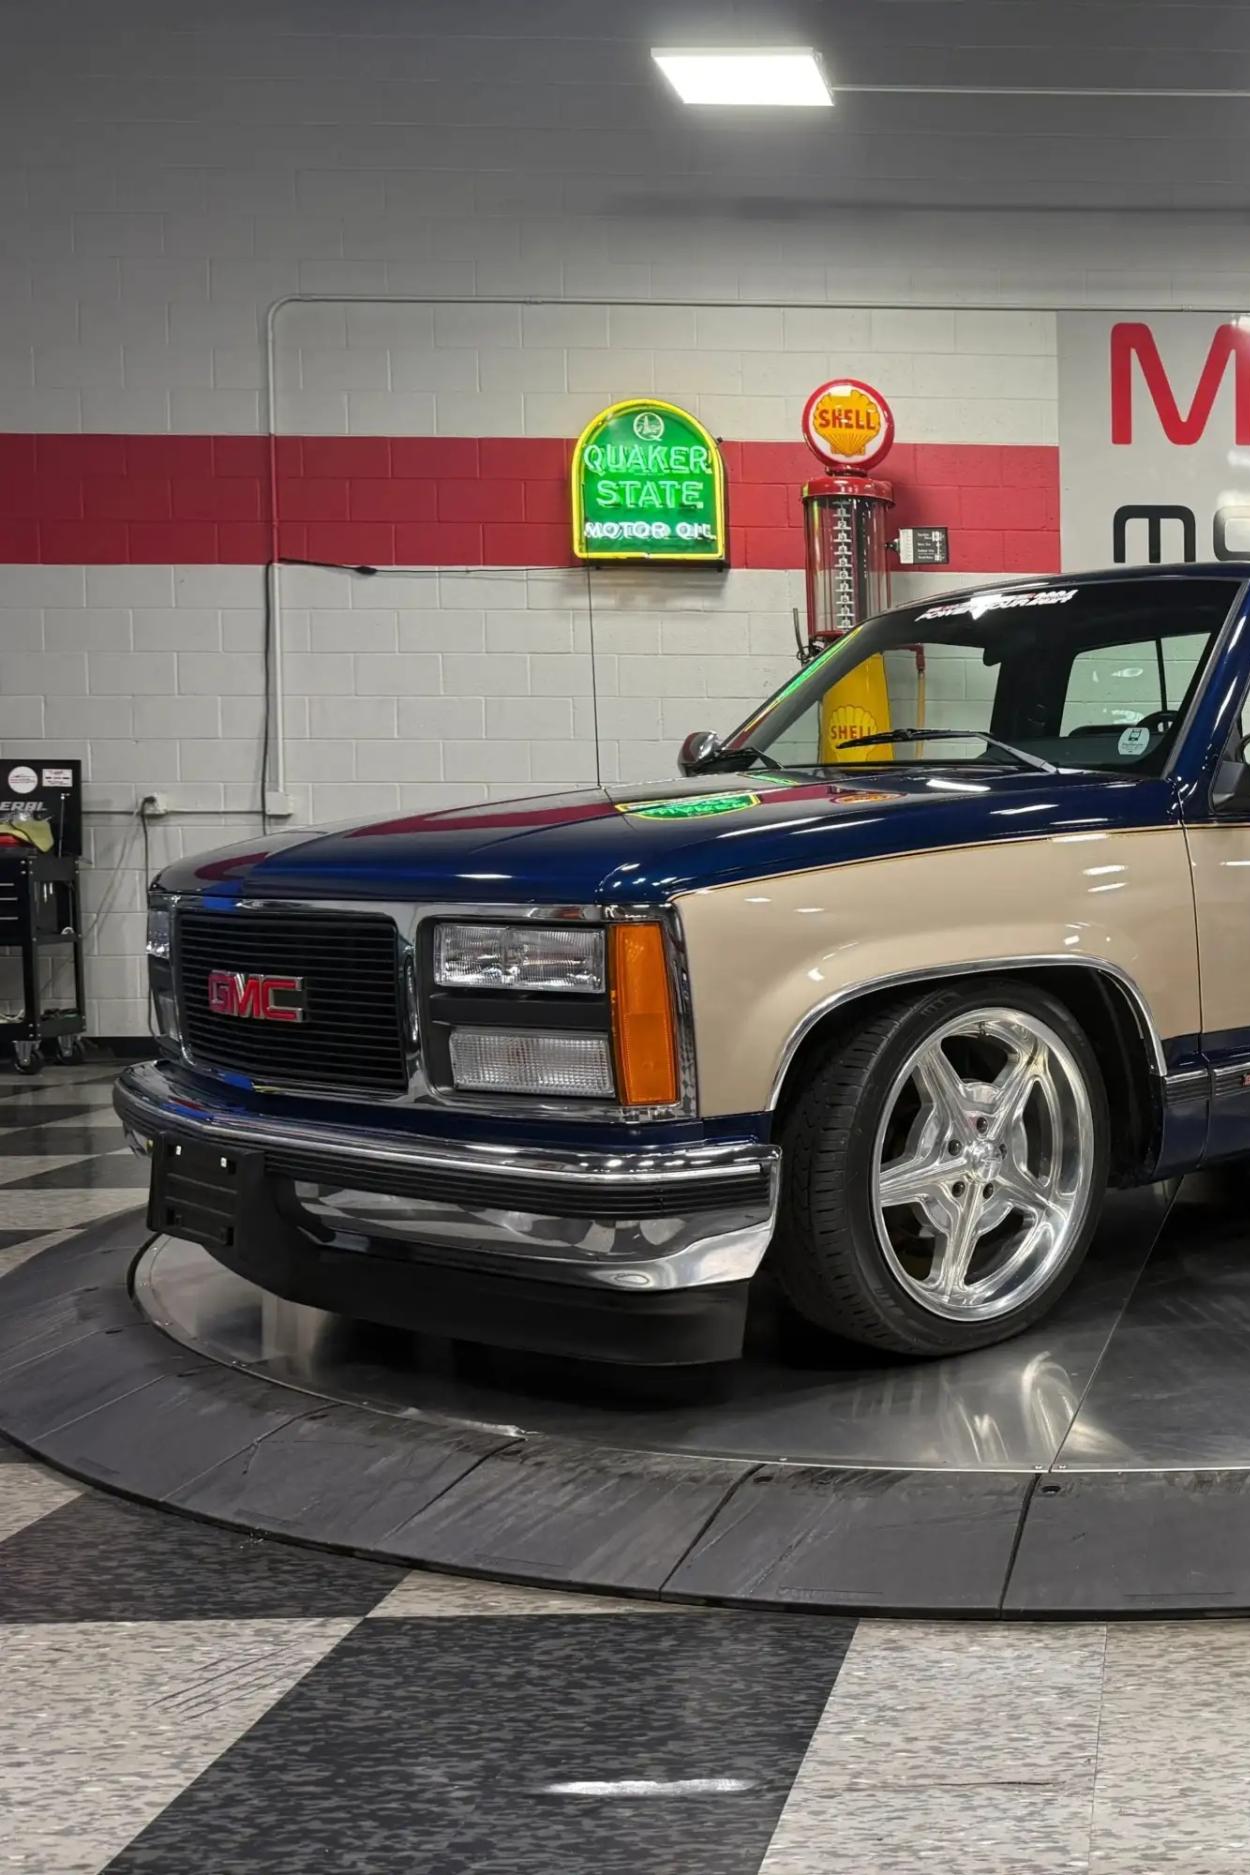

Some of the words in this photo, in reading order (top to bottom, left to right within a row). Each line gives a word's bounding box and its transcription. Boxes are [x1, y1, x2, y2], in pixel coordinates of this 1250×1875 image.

[819, 409, 876, 430] SHELL
[584, 444, 713, 476] QUAKER
[596, 480, 704, 508] STATE
[584, 521, 671, 540] MOTOR
[676, 521, 716, 540] OIL
[208, 969, 304, 1022] GMC
